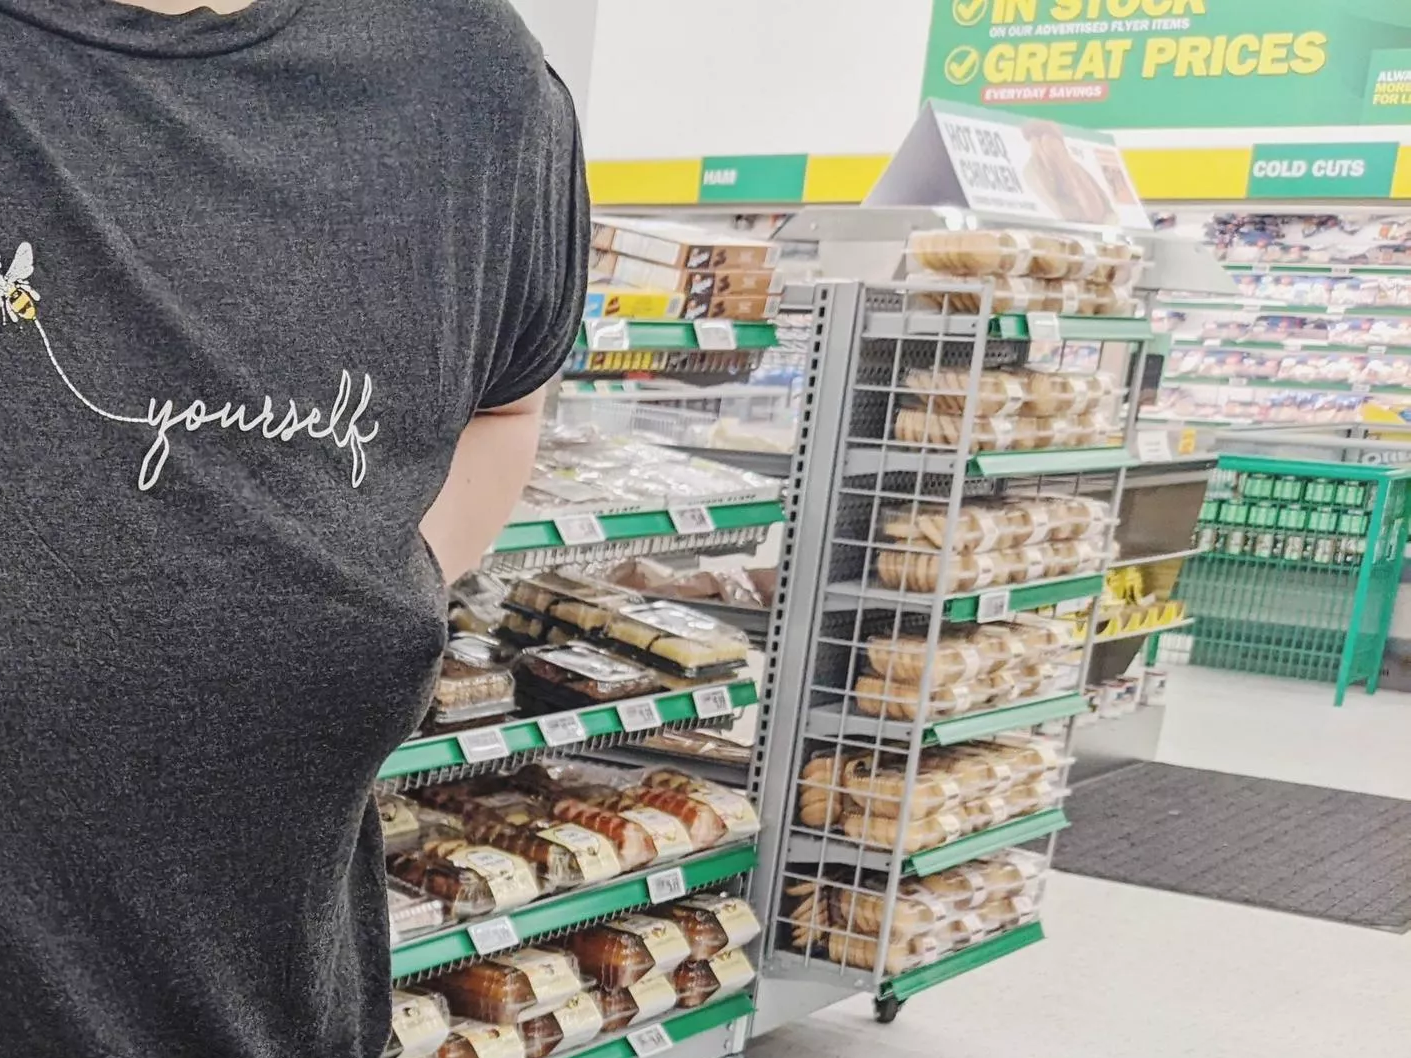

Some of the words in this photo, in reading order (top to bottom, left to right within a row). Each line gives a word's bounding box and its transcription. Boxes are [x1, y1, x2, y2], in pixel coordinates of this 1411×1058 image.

[989, 27, 1006, 38] ON
[1008, 26, 1032, 37] OUR
[1035, 22, 1109, 36] ADVERTISED
[1110, 20, 1149, 32] FLYER
[1151, 18, 1191, 31] ITEMS
[983, 39, 1132, 83] GREAT
[1142, 32, 1327, 78] PRICES
[985, 88, 1045, 101] EVERYDAY
[1048, 86, 1102, 98] SAVINGS
[1373, 94, 1398, 105] FOR
[944, 122, 976, 156] HOT
[975, 129, 1011, 165] BBQ
[703, 169, 737, 186] HAM
[960, 159, 1023, 194] CHICKEN
[1252, 160, 1307, 178] COLD
[1312, 159, 1365, 177] CUTS
[138, 369, 379, 491] yourself
